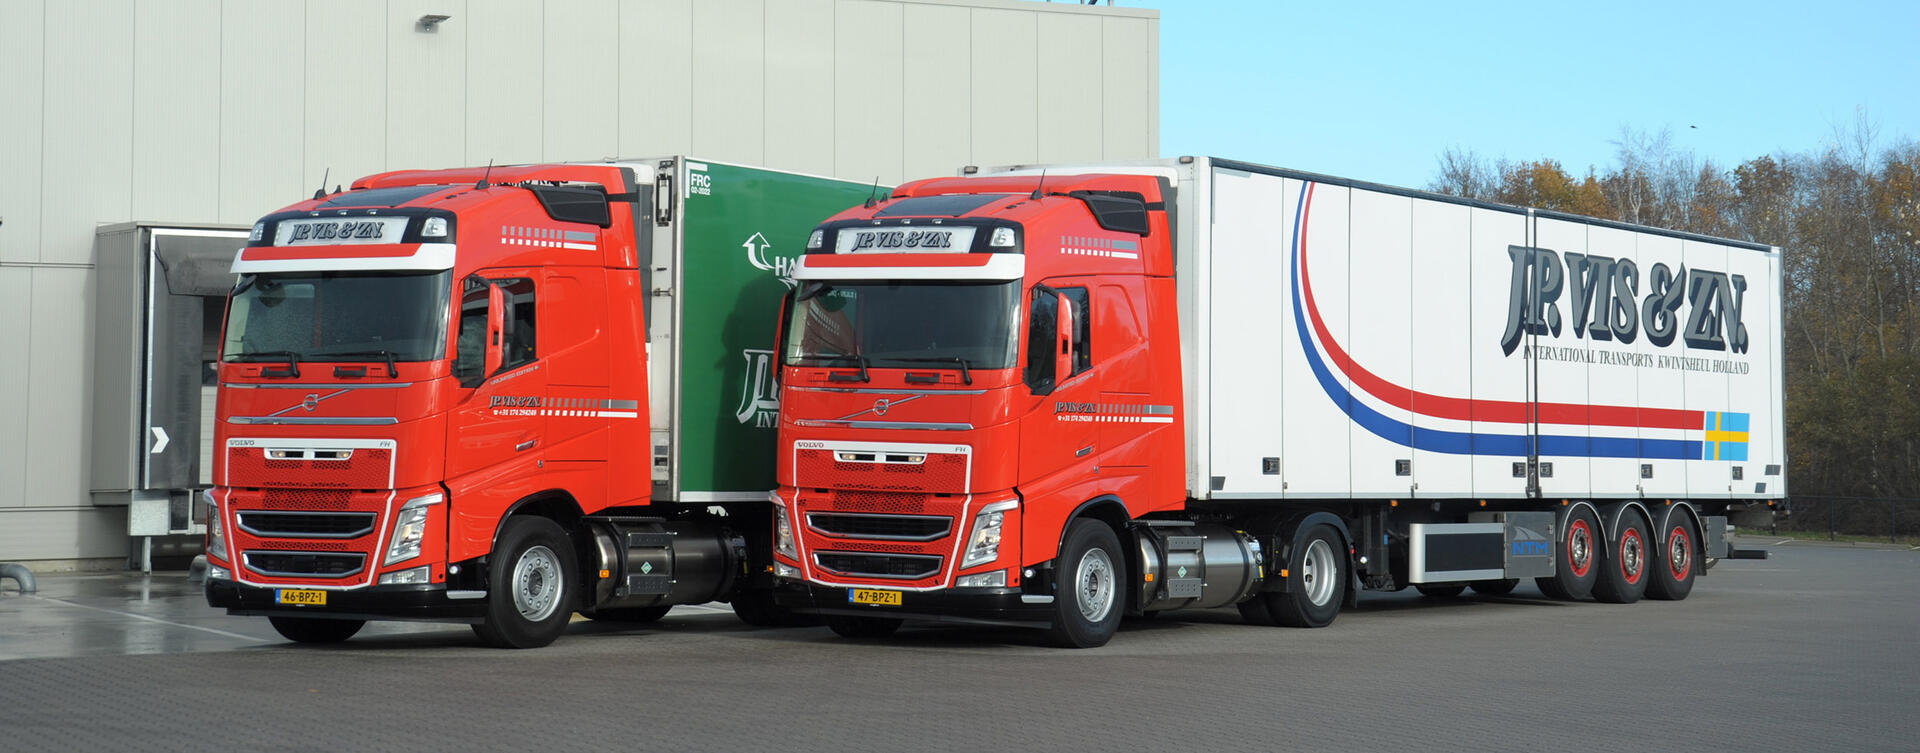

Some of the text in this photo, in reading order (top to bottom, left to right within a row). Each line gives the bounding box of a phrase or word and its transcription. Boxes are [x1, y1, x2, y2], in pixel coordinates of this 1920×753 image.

[691, 173, 711, 188] FRC
[312, 222, 339, 240] VIS
[338, 221, 358, 239] &
[875, 231, 904, 248] VIS
[904, 230, 925, 248] &
[1564, 251, 1639, 345] VIS
[1642, 262, 1687, 348] &
[1683, 268, 1749, 355] ZN.
[1599, 350, 1654, 368] TRANSPORTS
[1658, 355, 1711, 372] KWINTSHEUL
[1712, 359, 1749, 375] HOLLAND
[502, 395, 517, 407] VIS
[517, 395, 528, 407] &
[1065, 401, 1077, 413] VIS
[1077, 402, 1085, 413] &
[1512, 541, 1548, 556] NTM
[284, 591, 322, 603] 46-BPZ-1
[858, 591, 897, 603] 47-BPZ-1
